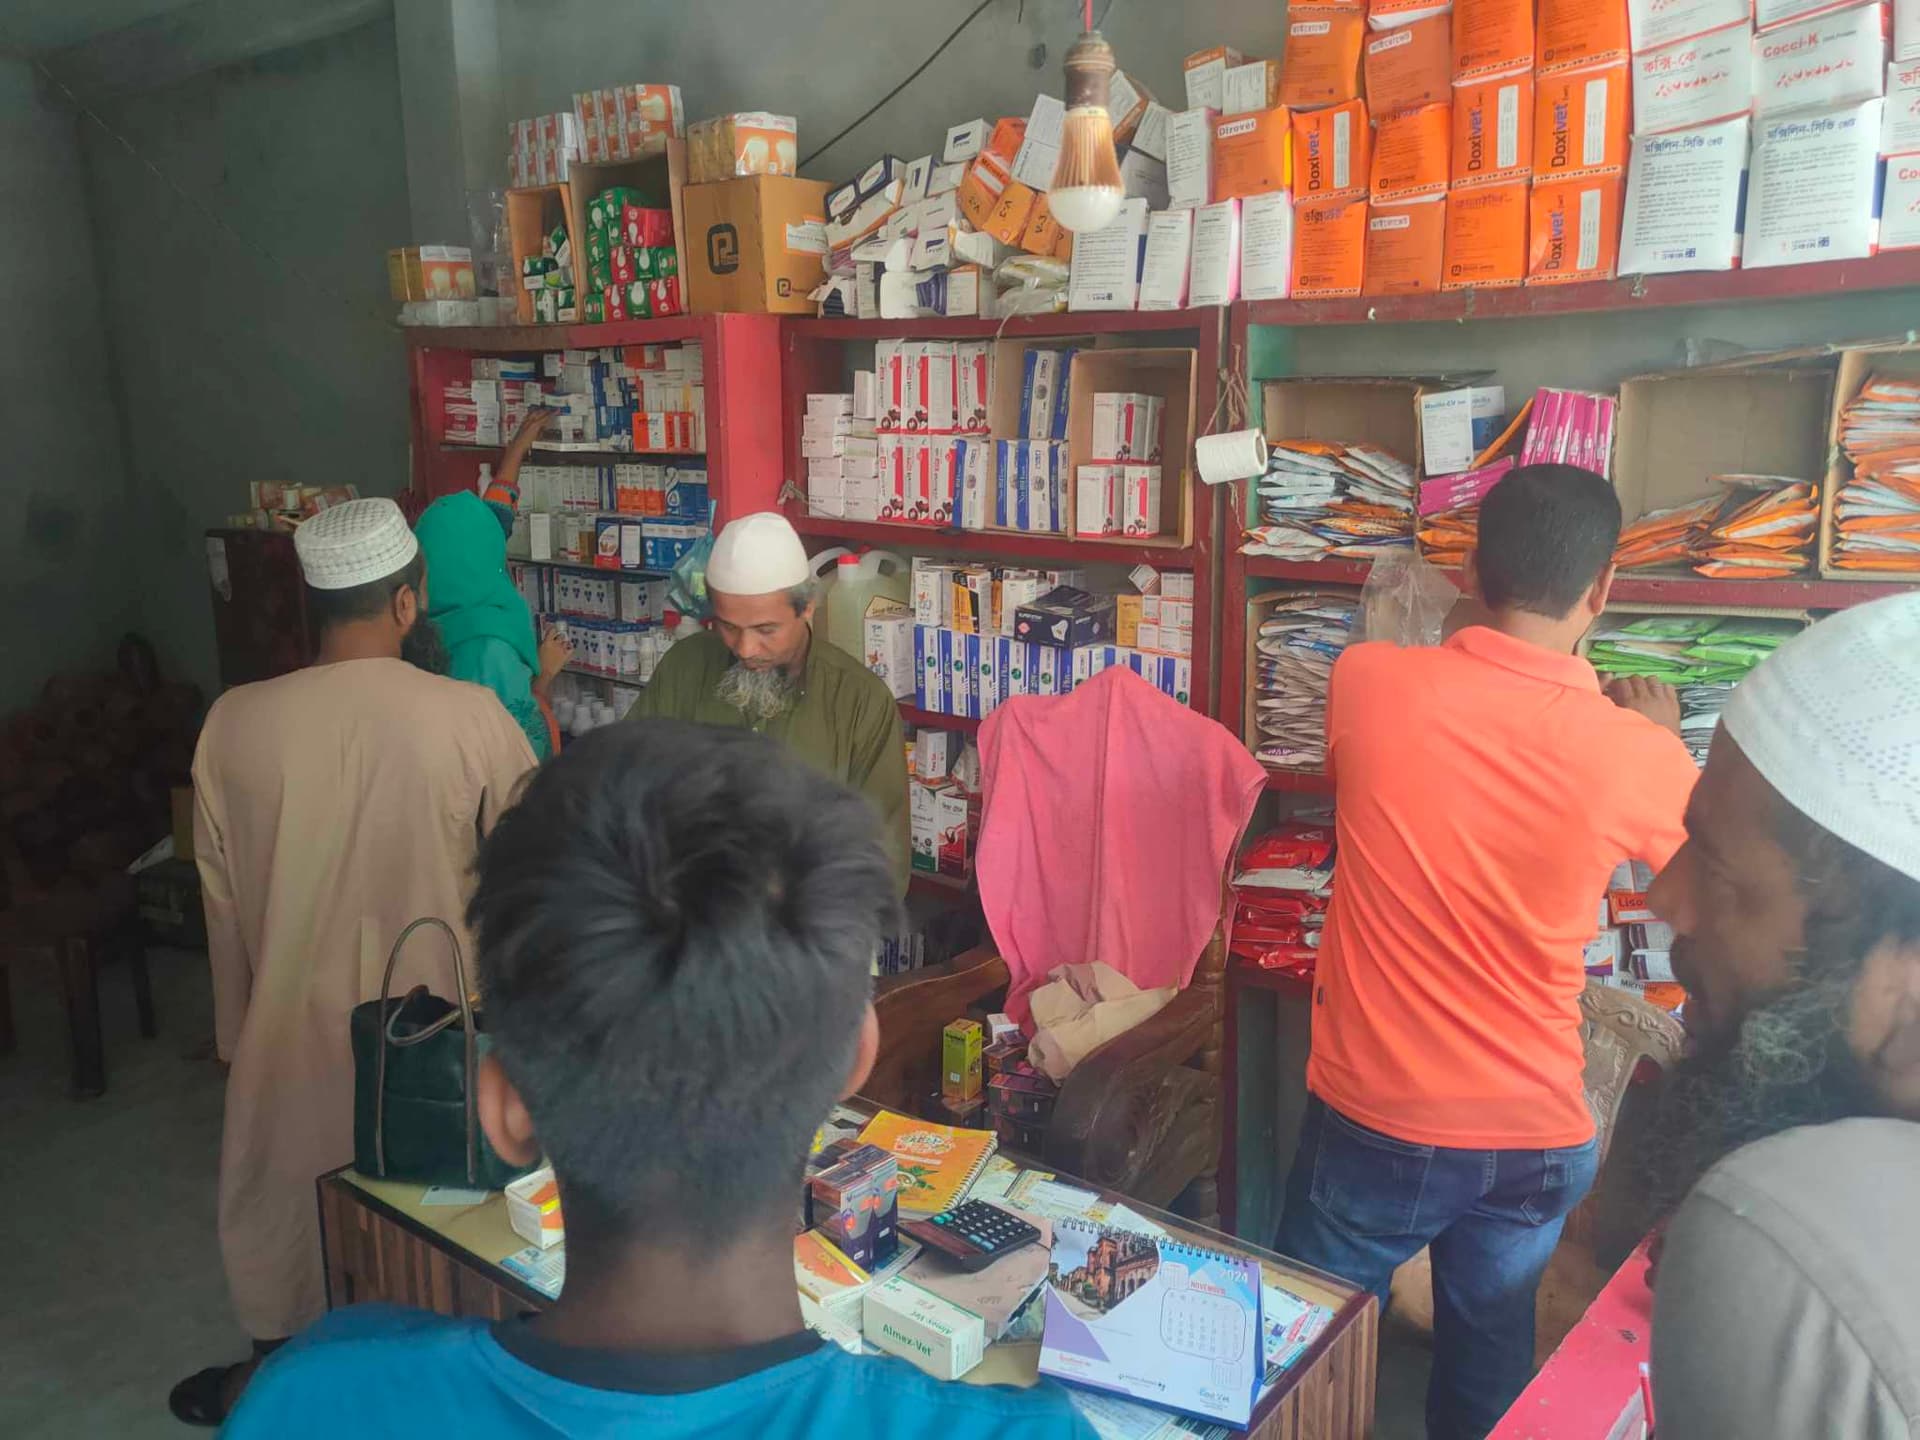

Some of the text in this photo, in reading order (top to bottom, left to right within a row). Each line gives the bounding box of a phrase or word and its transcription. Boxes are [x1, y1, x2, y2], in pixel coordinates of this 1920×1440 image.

[1307, 131, 1320, 191] Doxivet
[1468, 108, 1483, 171] Doxivet
[1551, 103, 1568, 168] Doxivet
[1545, 211, 1563, 270] Doxivet
[882, 1322, 932, 1357] Almex-Vet
